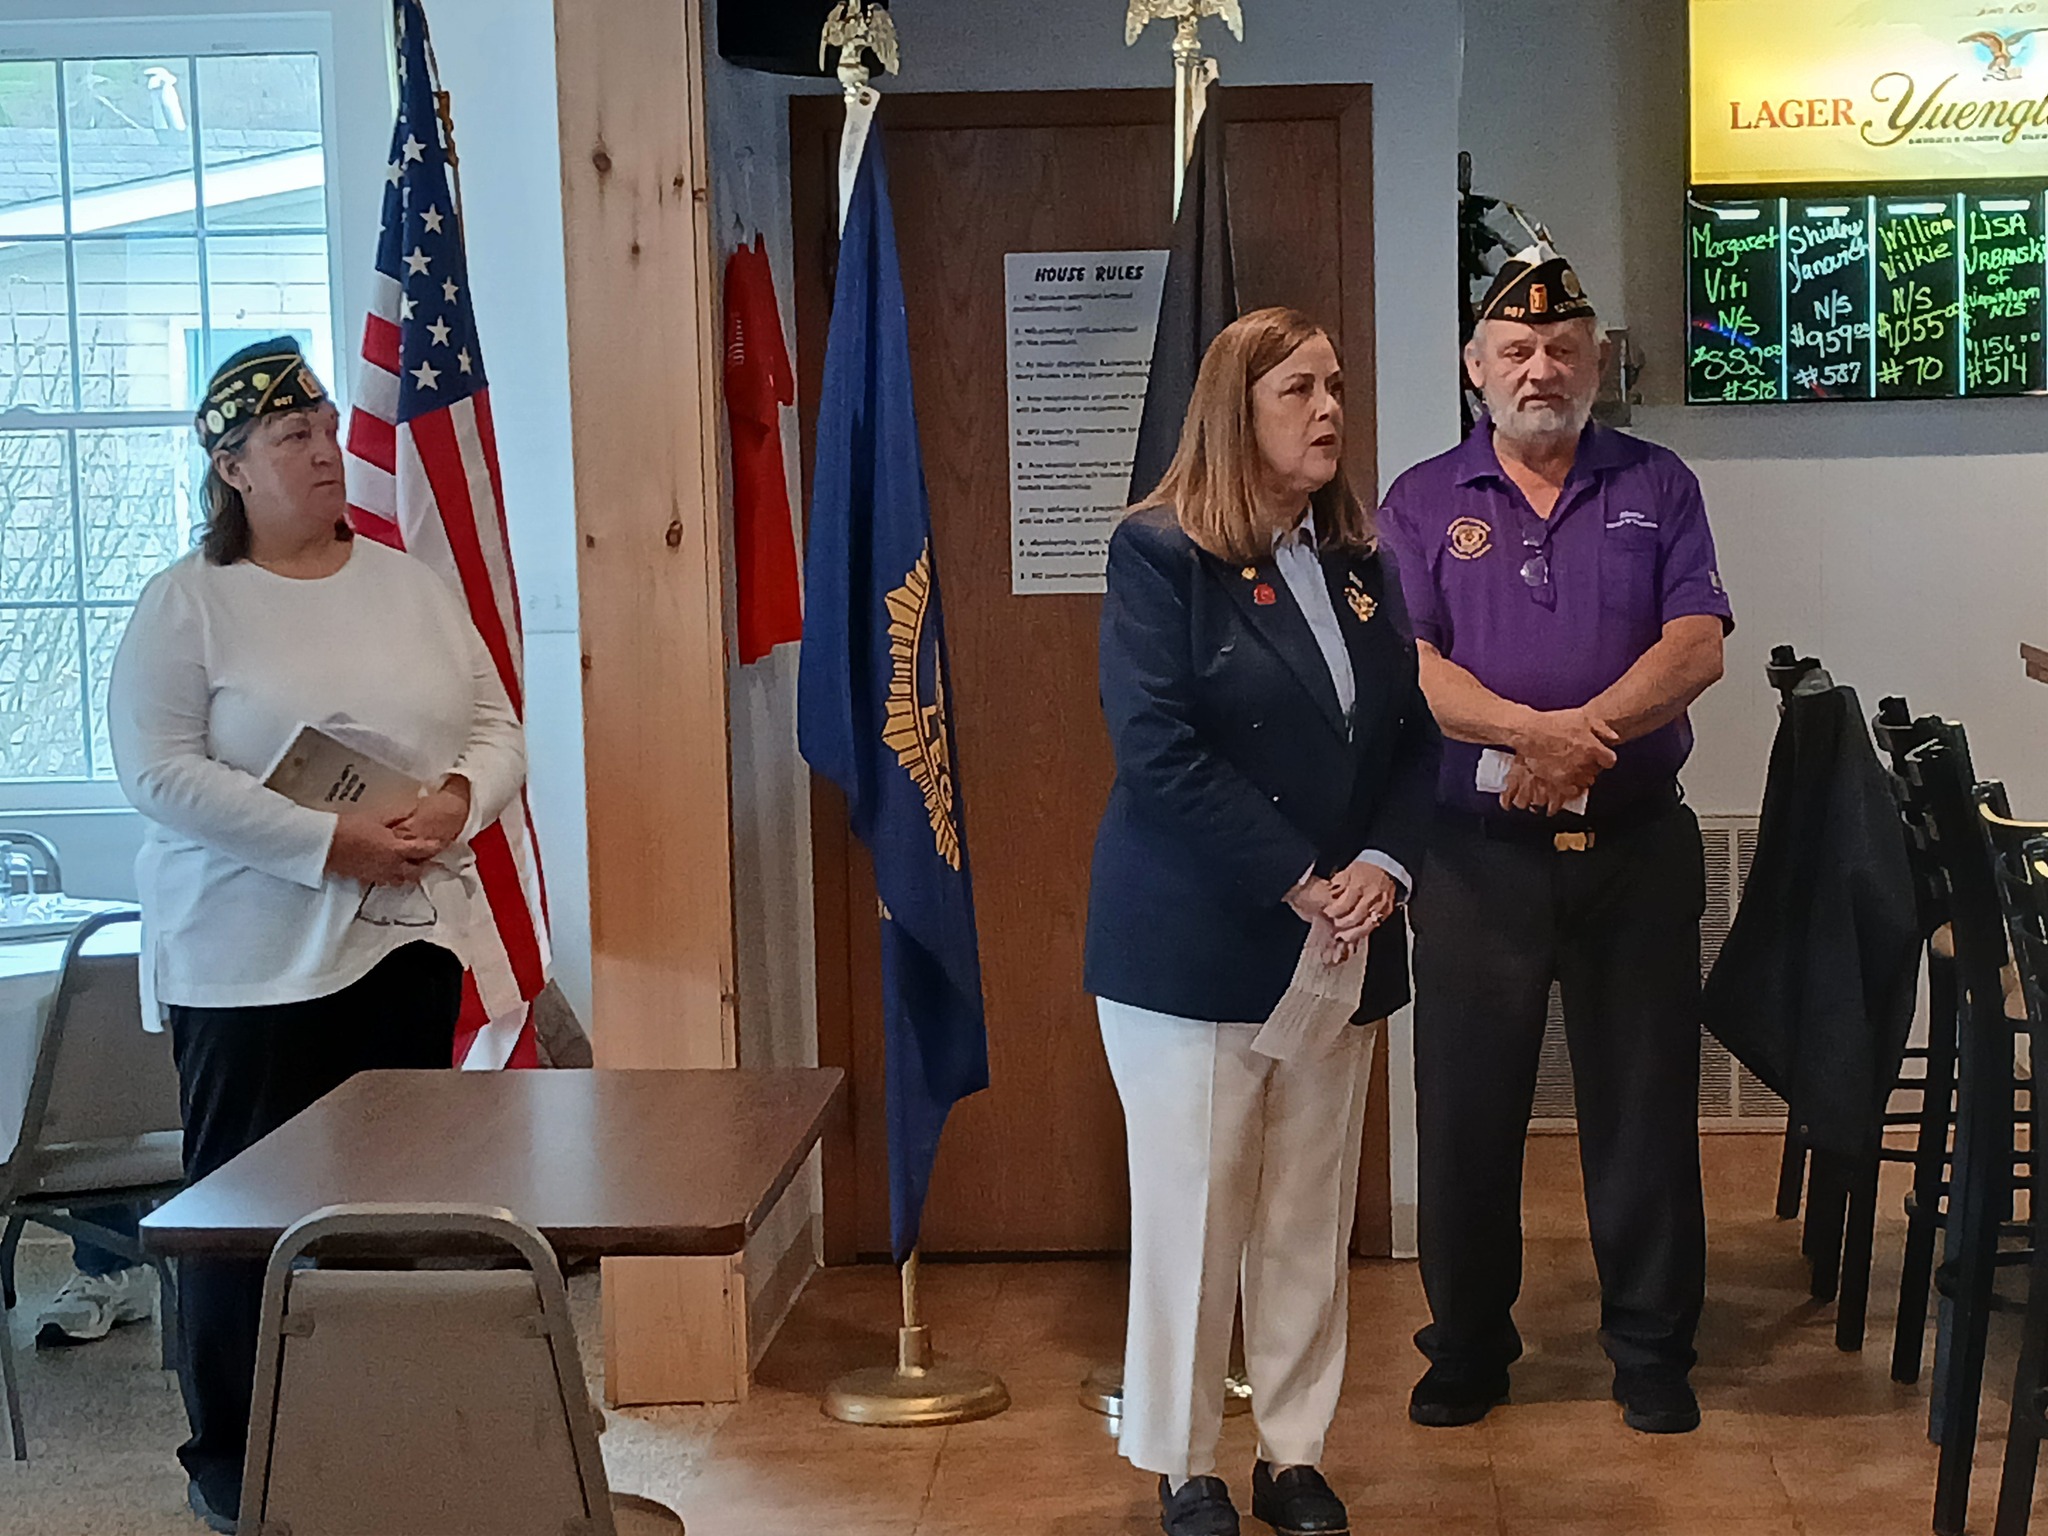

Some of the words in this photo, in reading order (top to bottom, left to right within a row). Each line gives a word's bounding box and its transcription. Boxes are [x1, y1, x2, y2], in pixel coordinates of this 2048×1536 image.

[1730, 98, 1856, 130] LAGER
[1692, 222, 1780, 267] Margaret
[1034, 267, 1086, 283] HOUSE
[1094, 265, 1145, 283] RULES
[1967, 352, 2028, 389] #514
